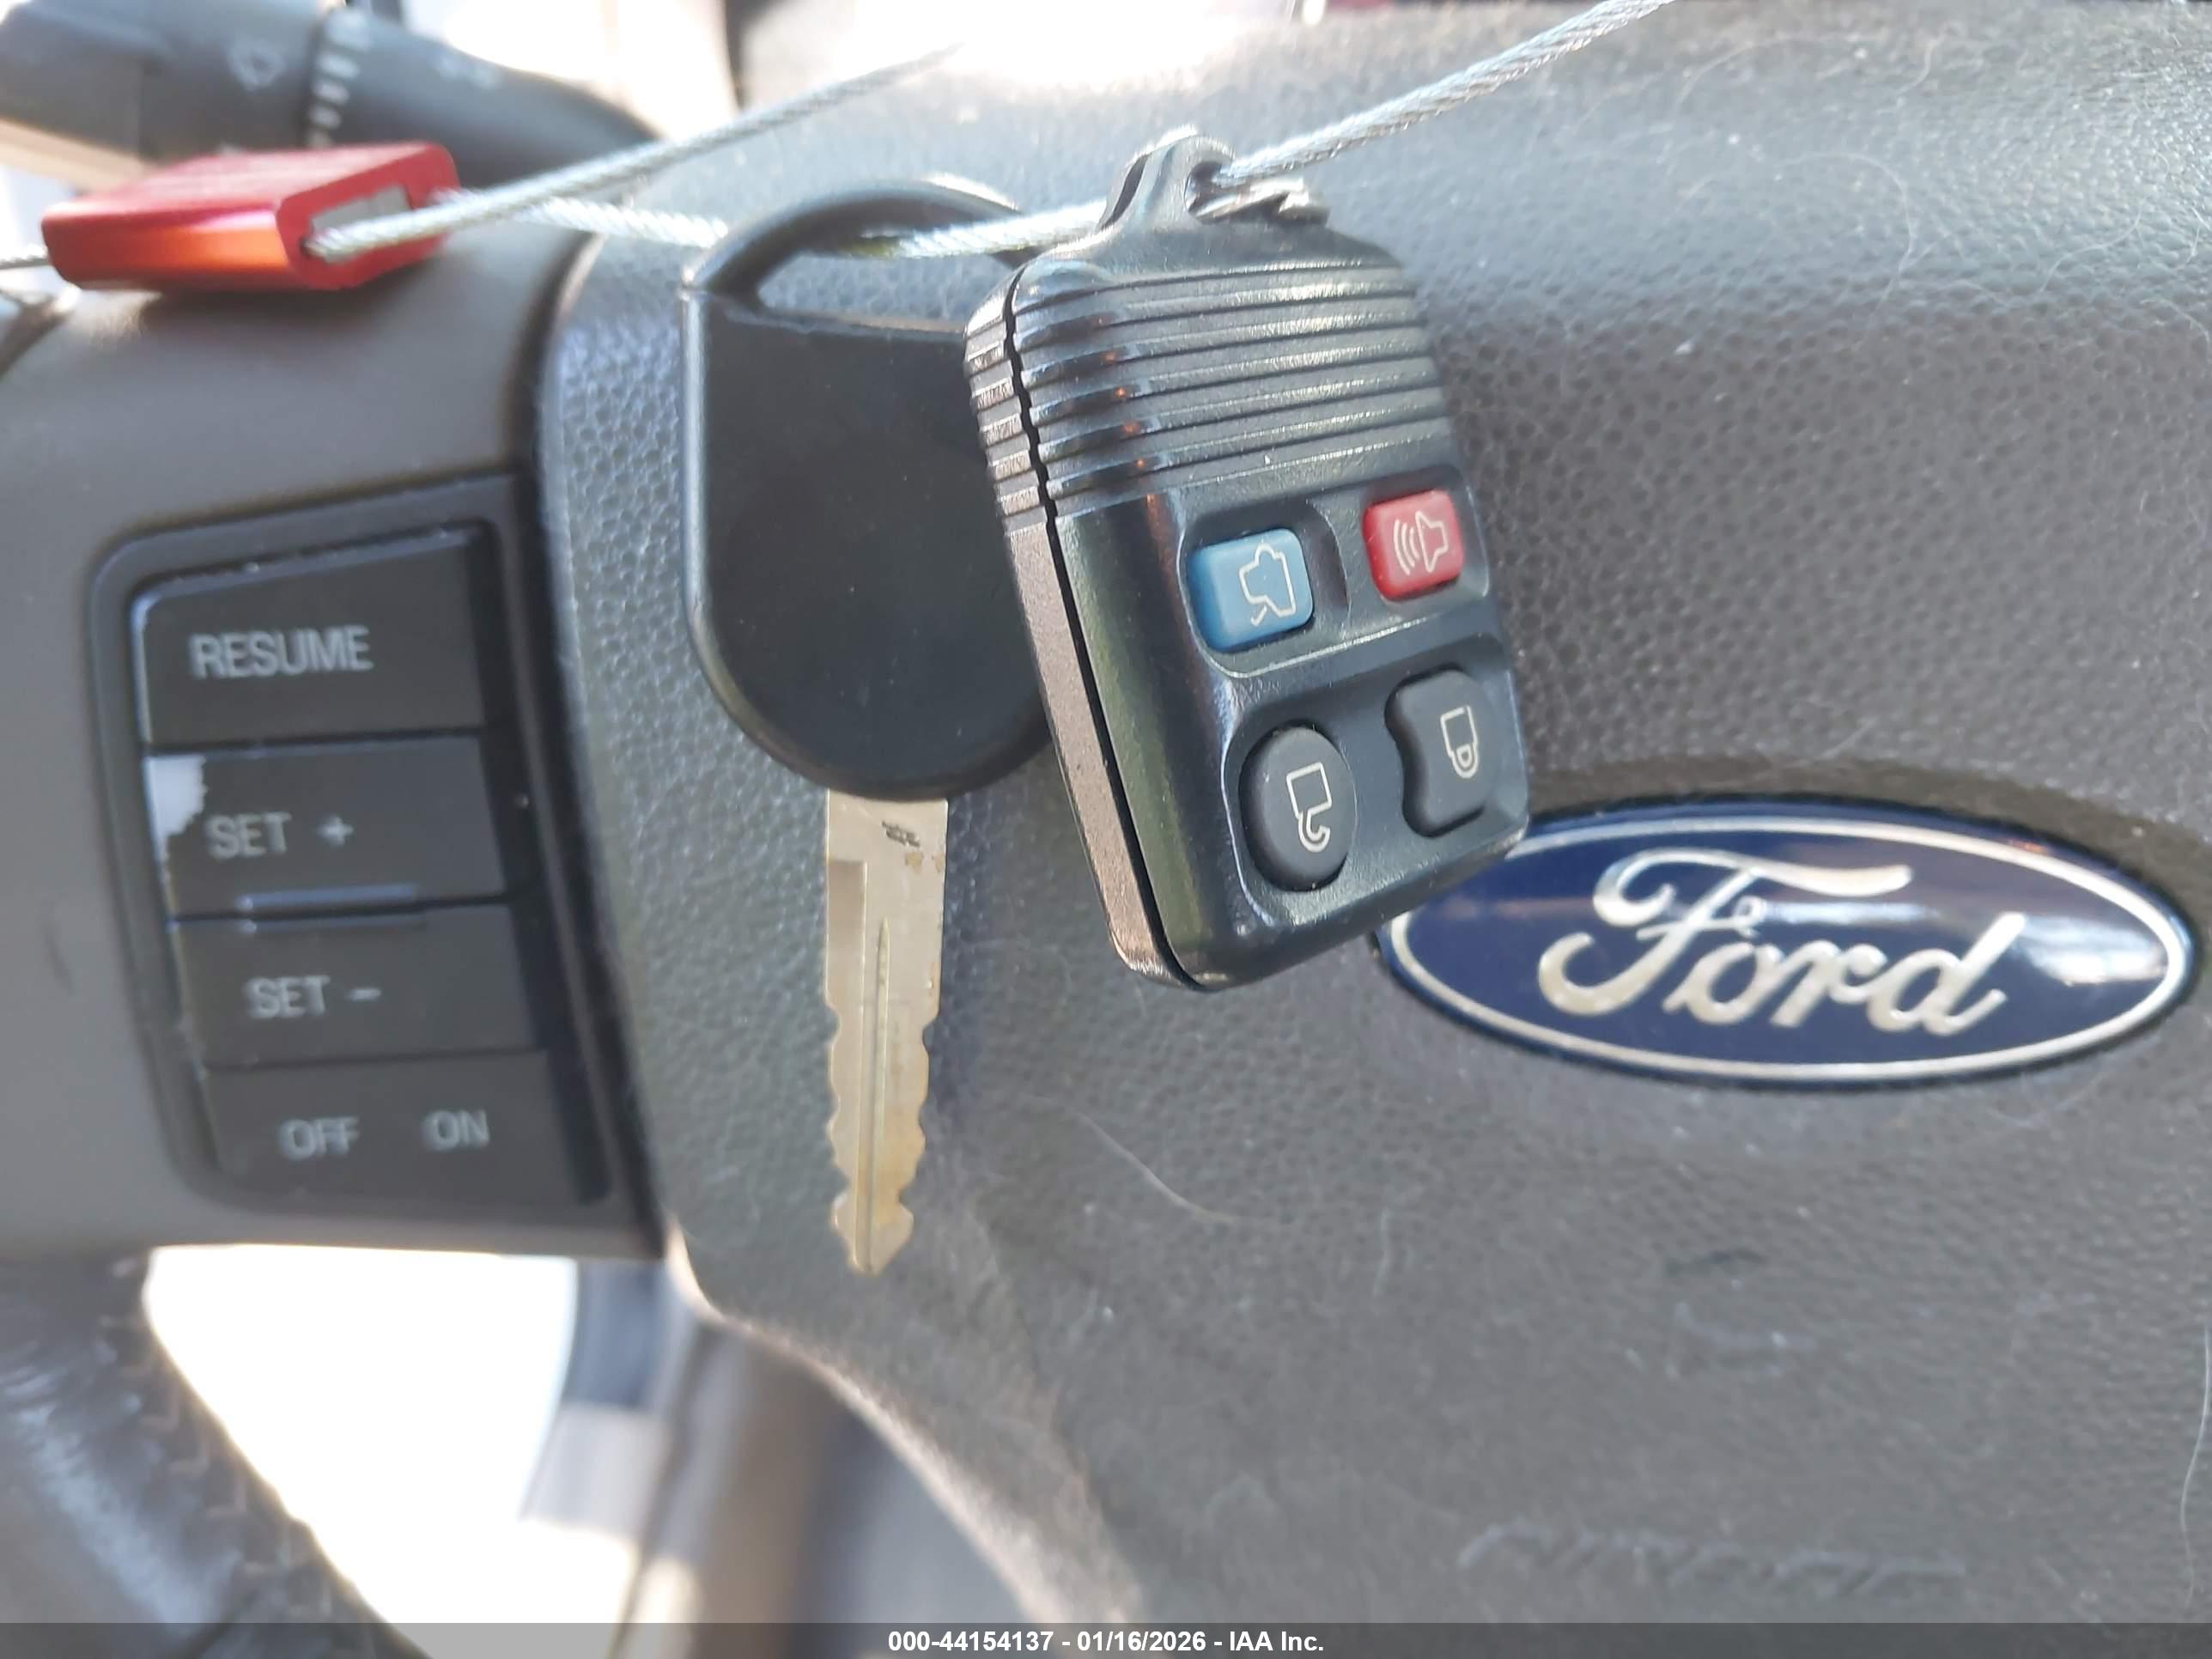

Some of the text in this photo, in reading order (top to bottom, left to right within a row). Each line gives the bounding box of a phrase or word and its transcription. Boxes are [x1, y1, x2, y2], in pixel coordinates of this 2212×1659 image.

[189, 625, 375, 680] RESUME
[205, 811, 354, 860] SET +
[1538, 847, 2027, 1037] Ford
[246, 975, 331, 1020] SET
[279, 1109, 490, 1161] OFF ON
